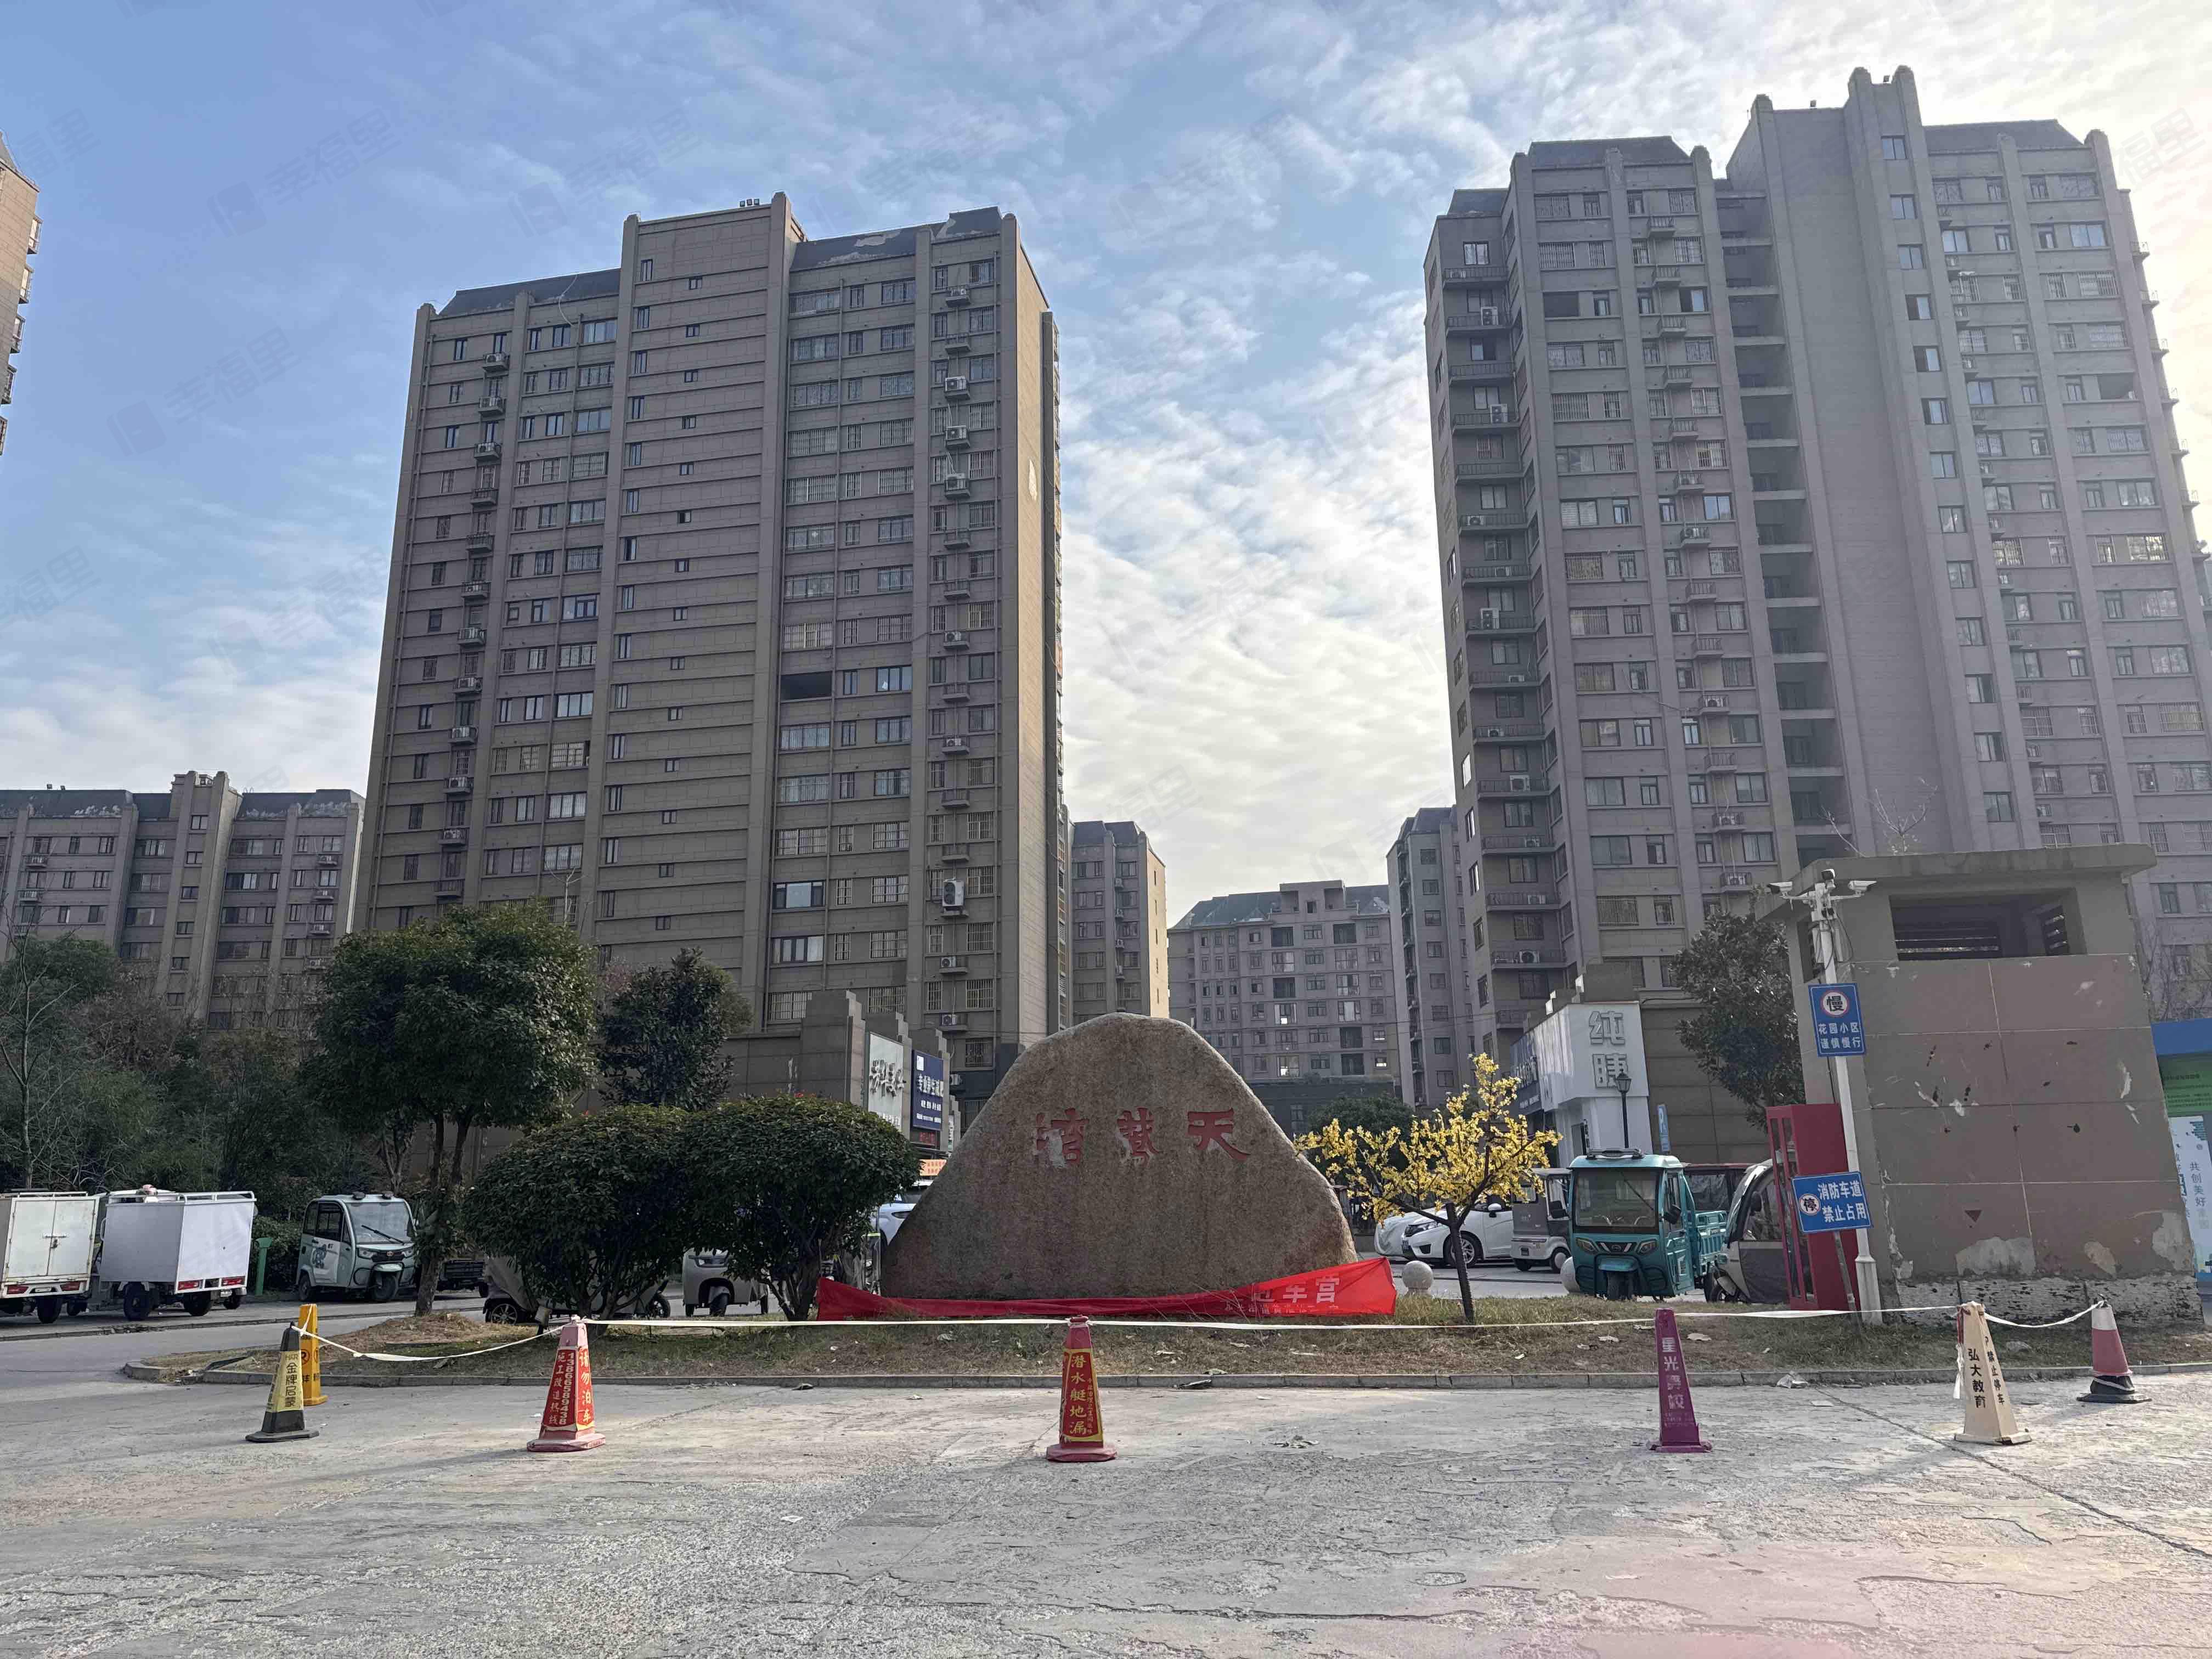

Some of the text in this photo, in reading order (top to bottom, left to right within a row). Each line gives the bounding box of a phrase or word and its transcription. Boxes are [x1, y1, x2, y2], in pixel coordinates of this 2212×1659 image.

[1826, 996, 1844, 1012] 慢
[1818, 1022, 1860, 1035] 花园小区
[1820, 1036, 1861, 1049] 谨慎慢行
[1818, 1181, 1863, 1200] 消防车道
[1804, 1198, 1817, 1211] 停
[1822, 1203, 1867, 1222] 禁止占用
[285, 1362, 298, 1407] 金牌启蒙
[1968, 1348, 1986, 1408] 弘大教育
[1987, 1350, 2005, 1405] 禁止停车
[579, 1352, 591, 1423] 请勿泊车
[1070, 1355, 1087, 1435] 潜水艇地漏
